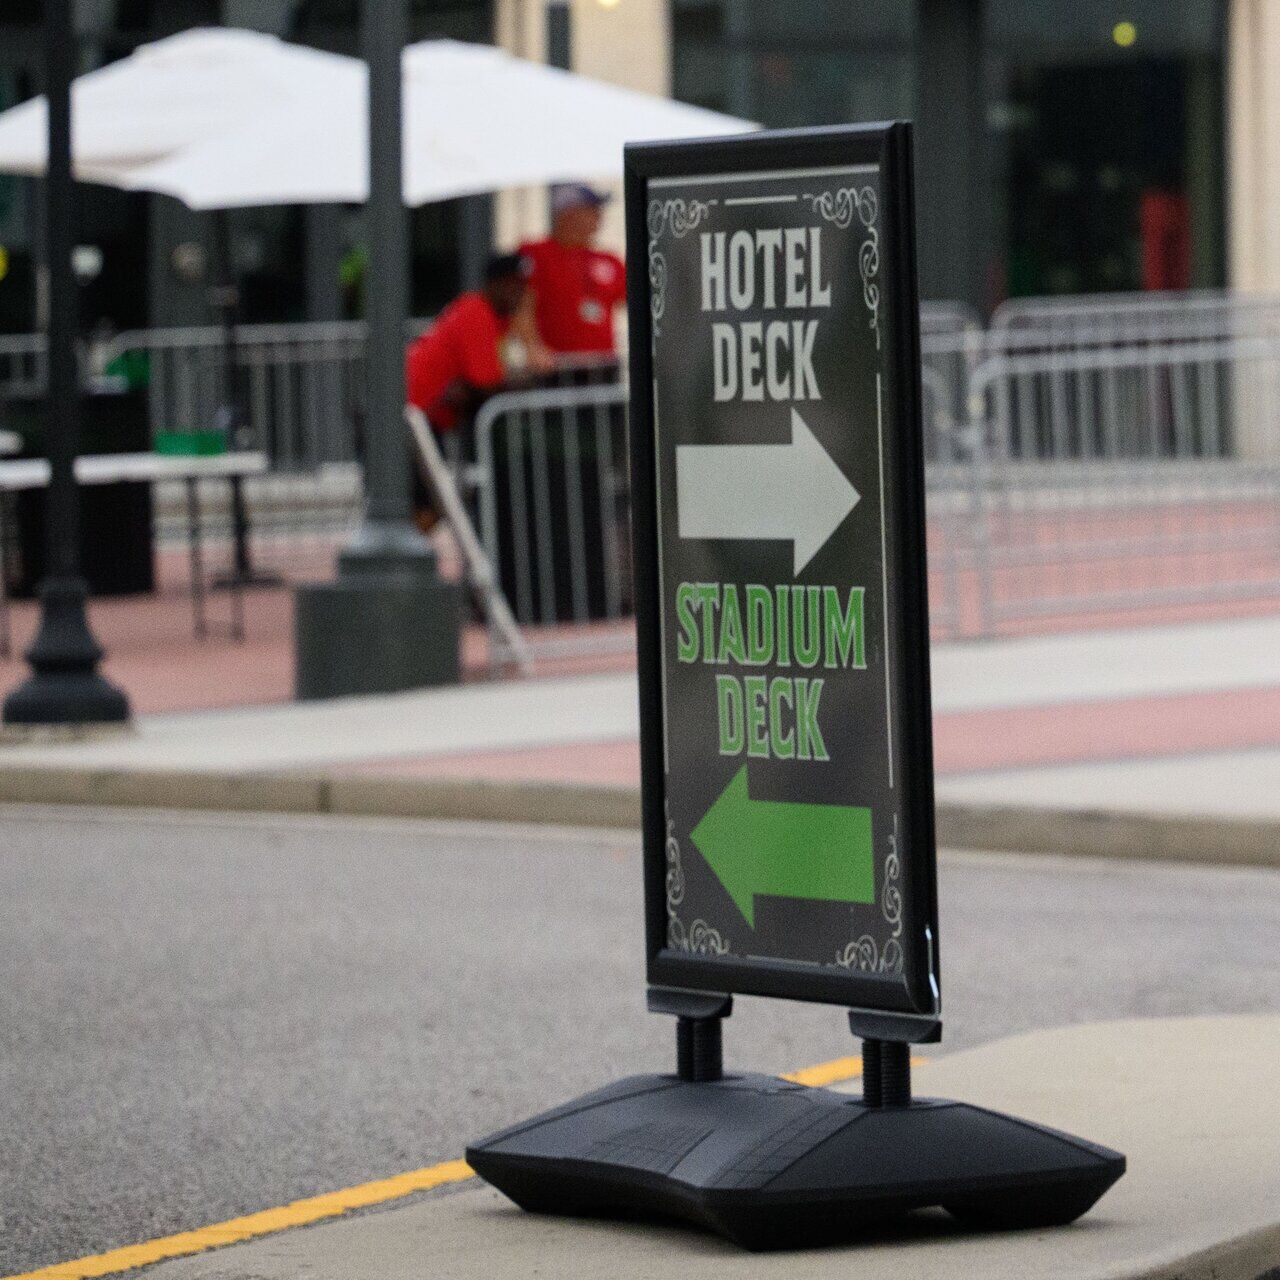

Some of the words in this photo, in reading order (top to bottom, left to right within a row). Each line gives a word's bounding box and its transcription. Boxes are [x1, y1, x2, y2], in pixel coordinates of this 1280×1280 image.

[700, 226, 832, 312] HOTEL
[712, 320, 822, 402] DECK
[675, 581, 868, 670] STADIUM
[715, 674, 831, 762] DECK
